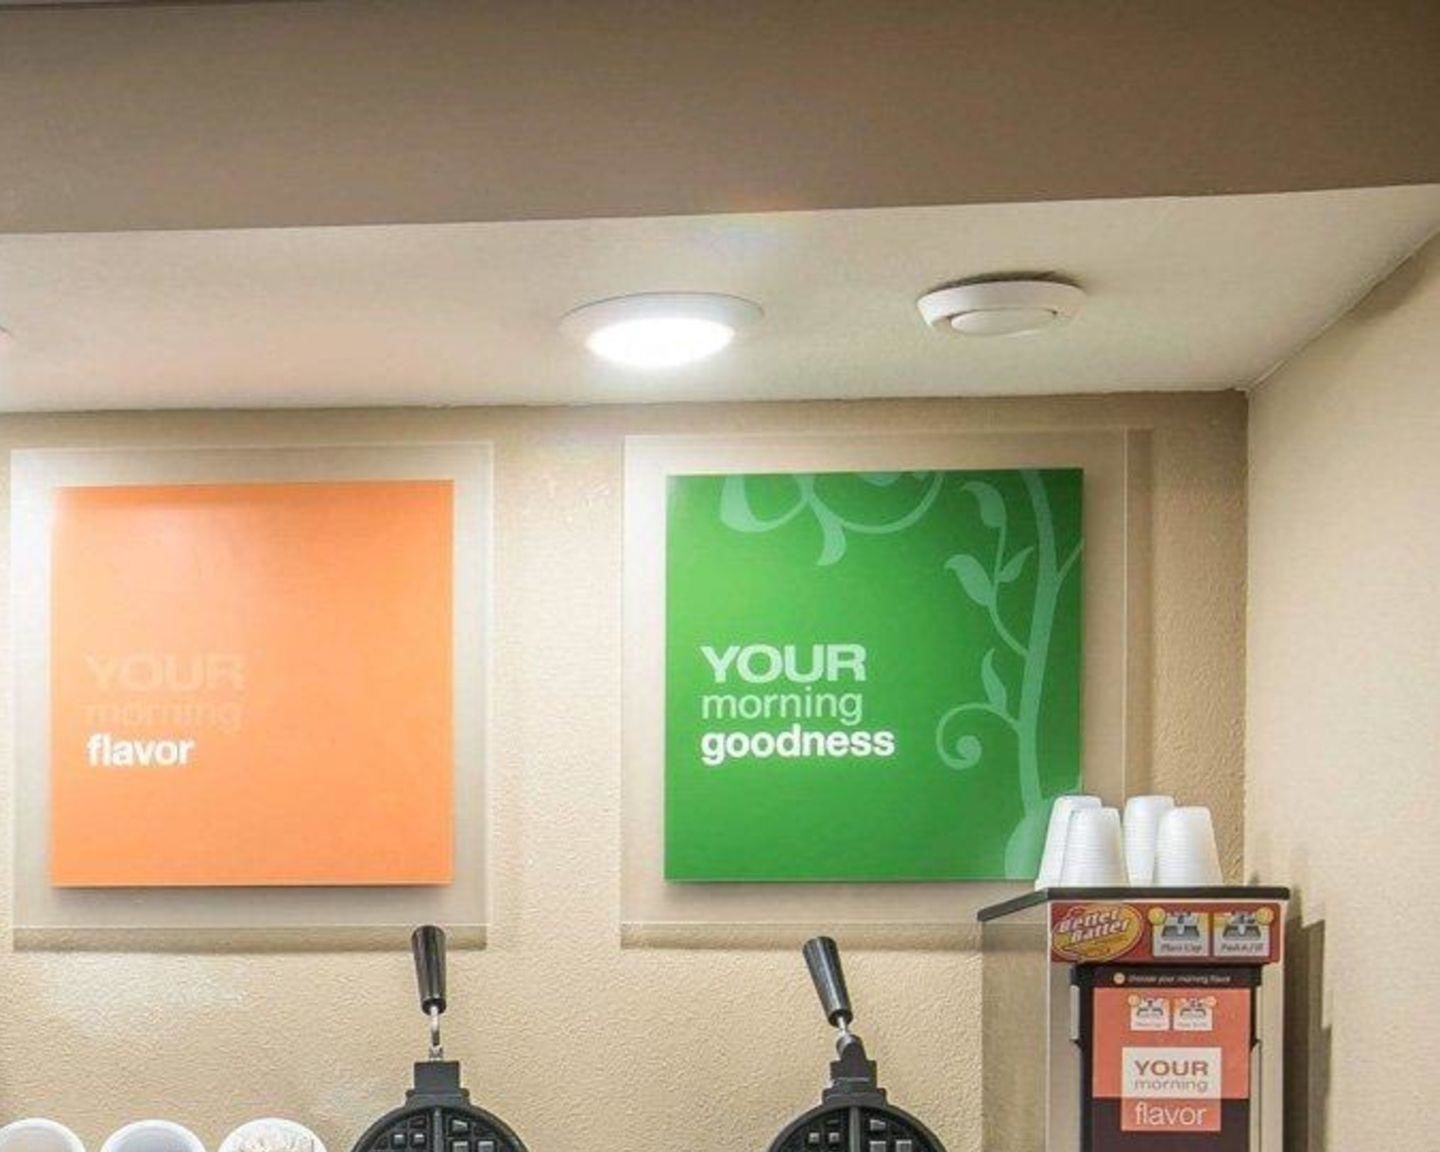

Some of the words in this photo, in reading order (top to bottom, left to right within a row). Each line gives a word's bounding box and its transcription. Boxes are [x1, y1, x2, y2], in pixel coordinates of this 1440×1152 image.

[85, 652, 246, 692] YOUR
[700, 643, 867, 683] YOUR
[701, 686, 863, 726] morning
[86, 732, 197, 768] flavor
[700, 723, 895, 766] goodness
[1133, 1059, 1209, 1077] YOUR
[1134, 1077, 1209, 1093] morning
[1134, 1101, 1208, 1126] flavor
